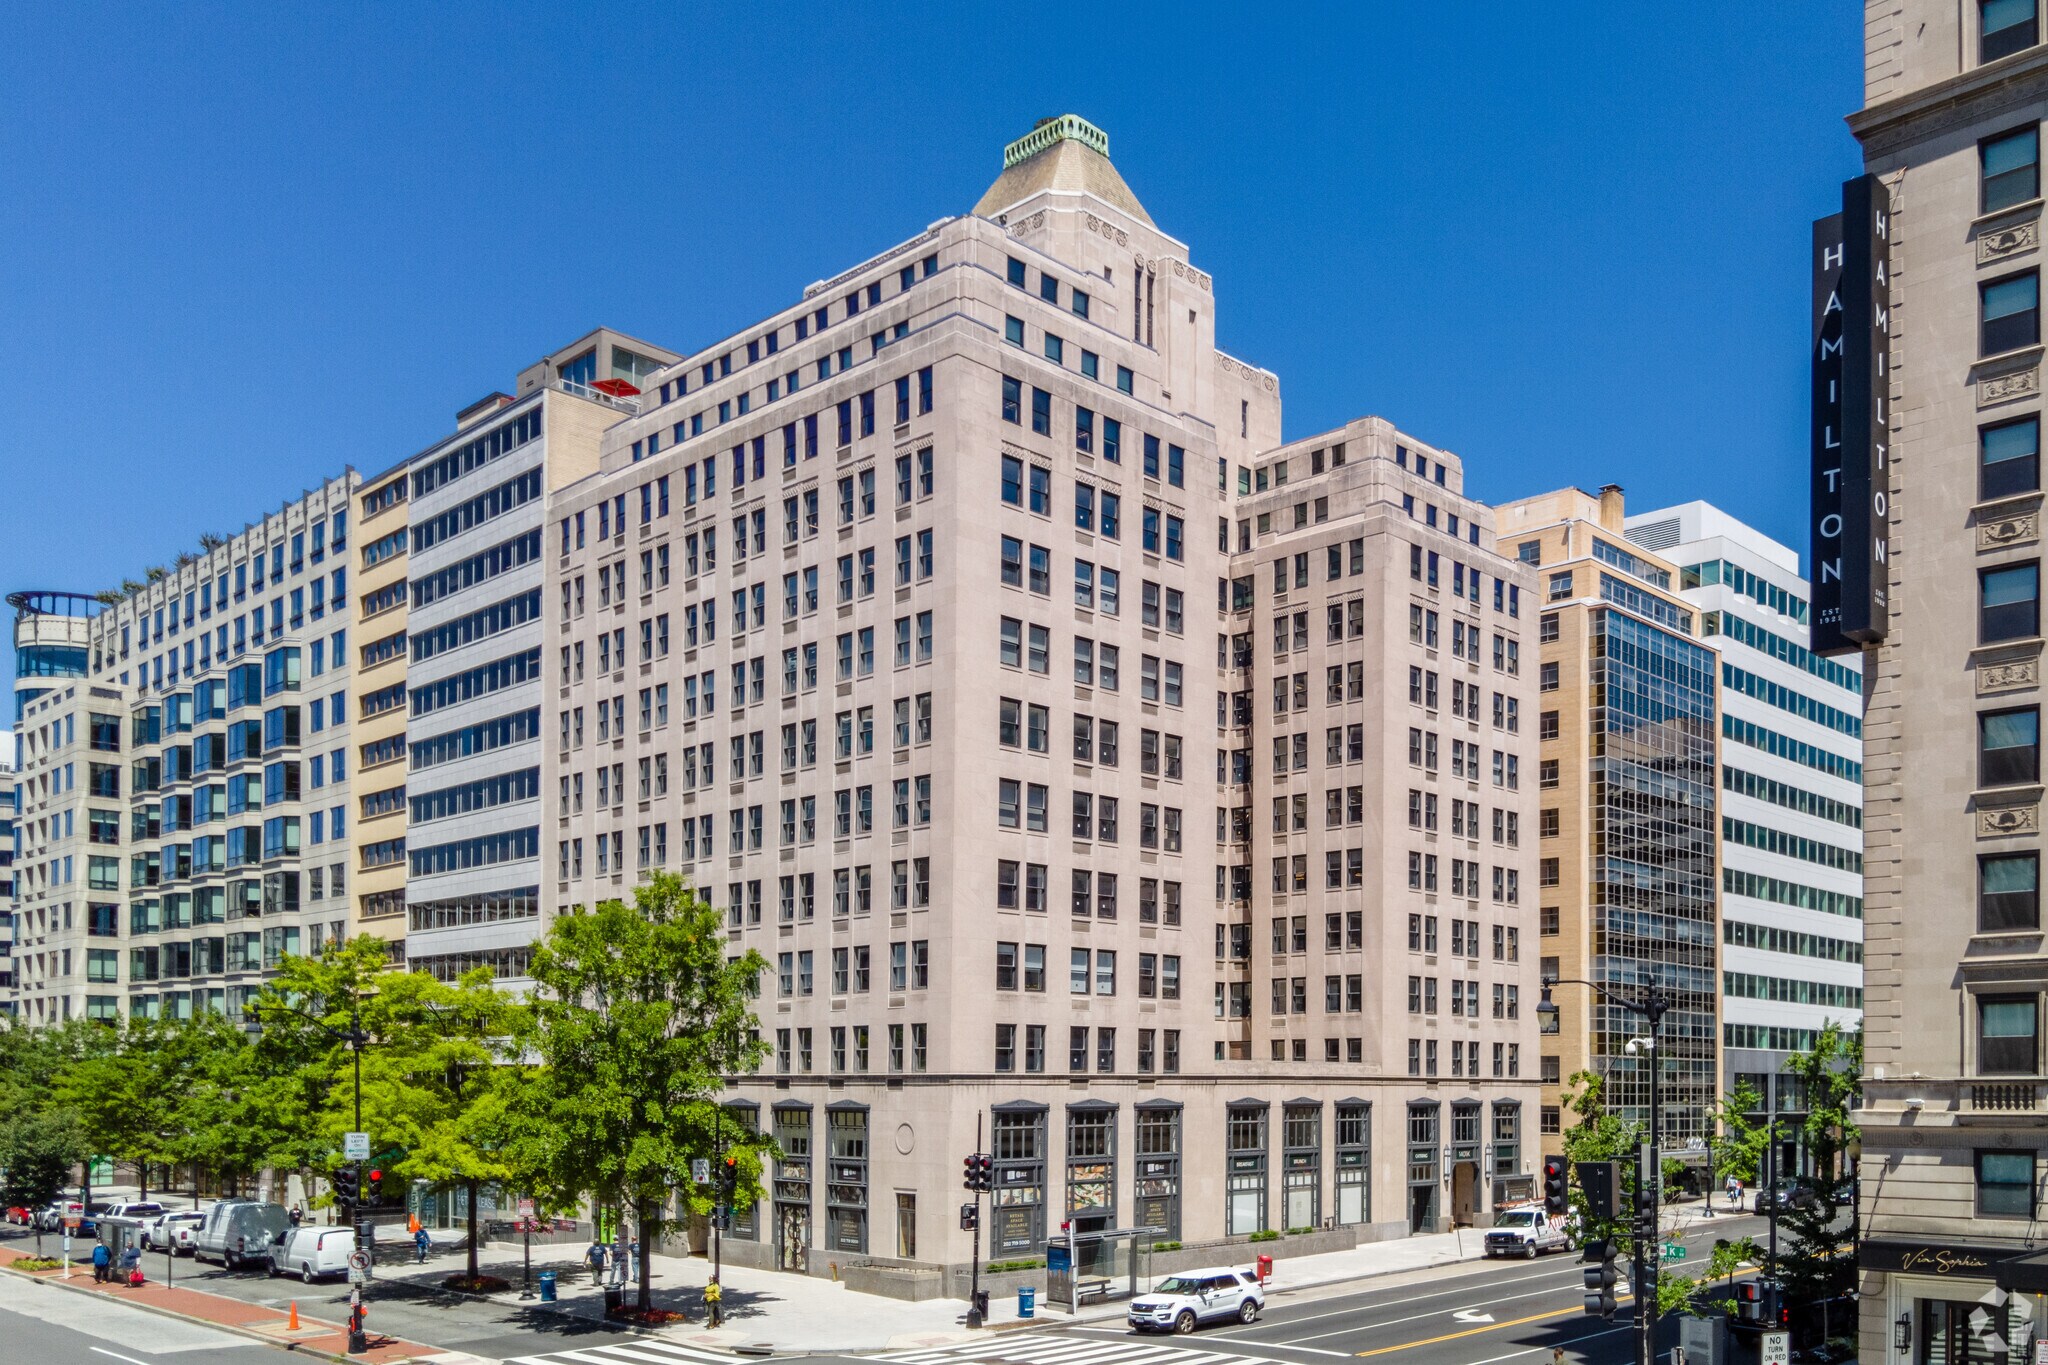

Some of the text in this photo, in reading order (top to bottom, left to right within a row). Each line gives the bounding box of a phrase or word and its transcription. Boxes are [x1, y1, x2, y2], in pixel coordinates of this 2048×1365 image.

[1874, 209, 1888, 565] HAMILTON
[1819, 242, 1844, 584] HAMILTON
[1818, 611, 1842, 625] 1922
[1669, 1247, 1676, 1257] K
[1902, 1247, 1988, 1274] Via Sophia
[1769, 1336, 1782, 1345] NO
[1768, 1345, 1784, 1354] TURN
[1764, 1353, 1787, 1362] ON RED
